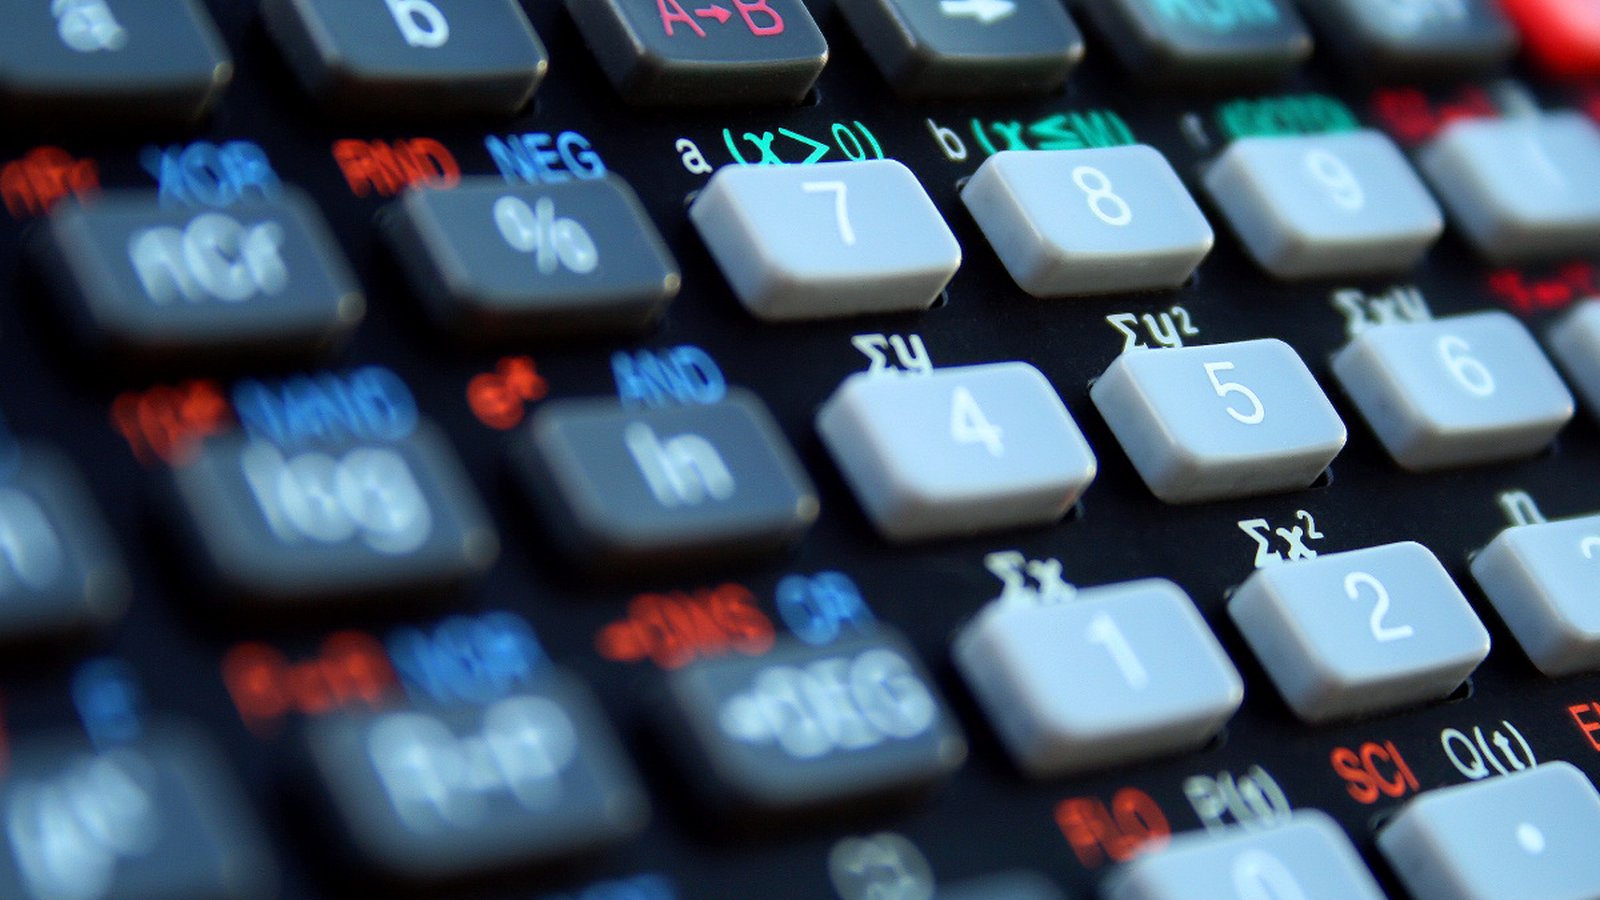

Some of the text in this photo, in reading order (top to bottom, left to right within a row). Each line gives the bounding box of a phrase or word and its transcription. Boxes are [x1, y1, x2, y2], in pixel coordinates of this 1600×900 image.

[484, 130, 606, 186] NEG
[675, 138, 713, 174] a
[927, 117, 968, 161] b
[1071, 165, 1132, 226] 8
[1306, 150, 1364, 211] 9
[493, 195, 599, 275] %
[802, 180, 857, 247] 7
[1203, 361, 1265, 424] 5
[1438, 335, 1496, 396] 6
[949, 386, 1005, 457] 4
[1343, 571, 1414, 643] 2
[1086, 609, 1150, 692] 1
[1329, 739, 1421, 805] SCI
